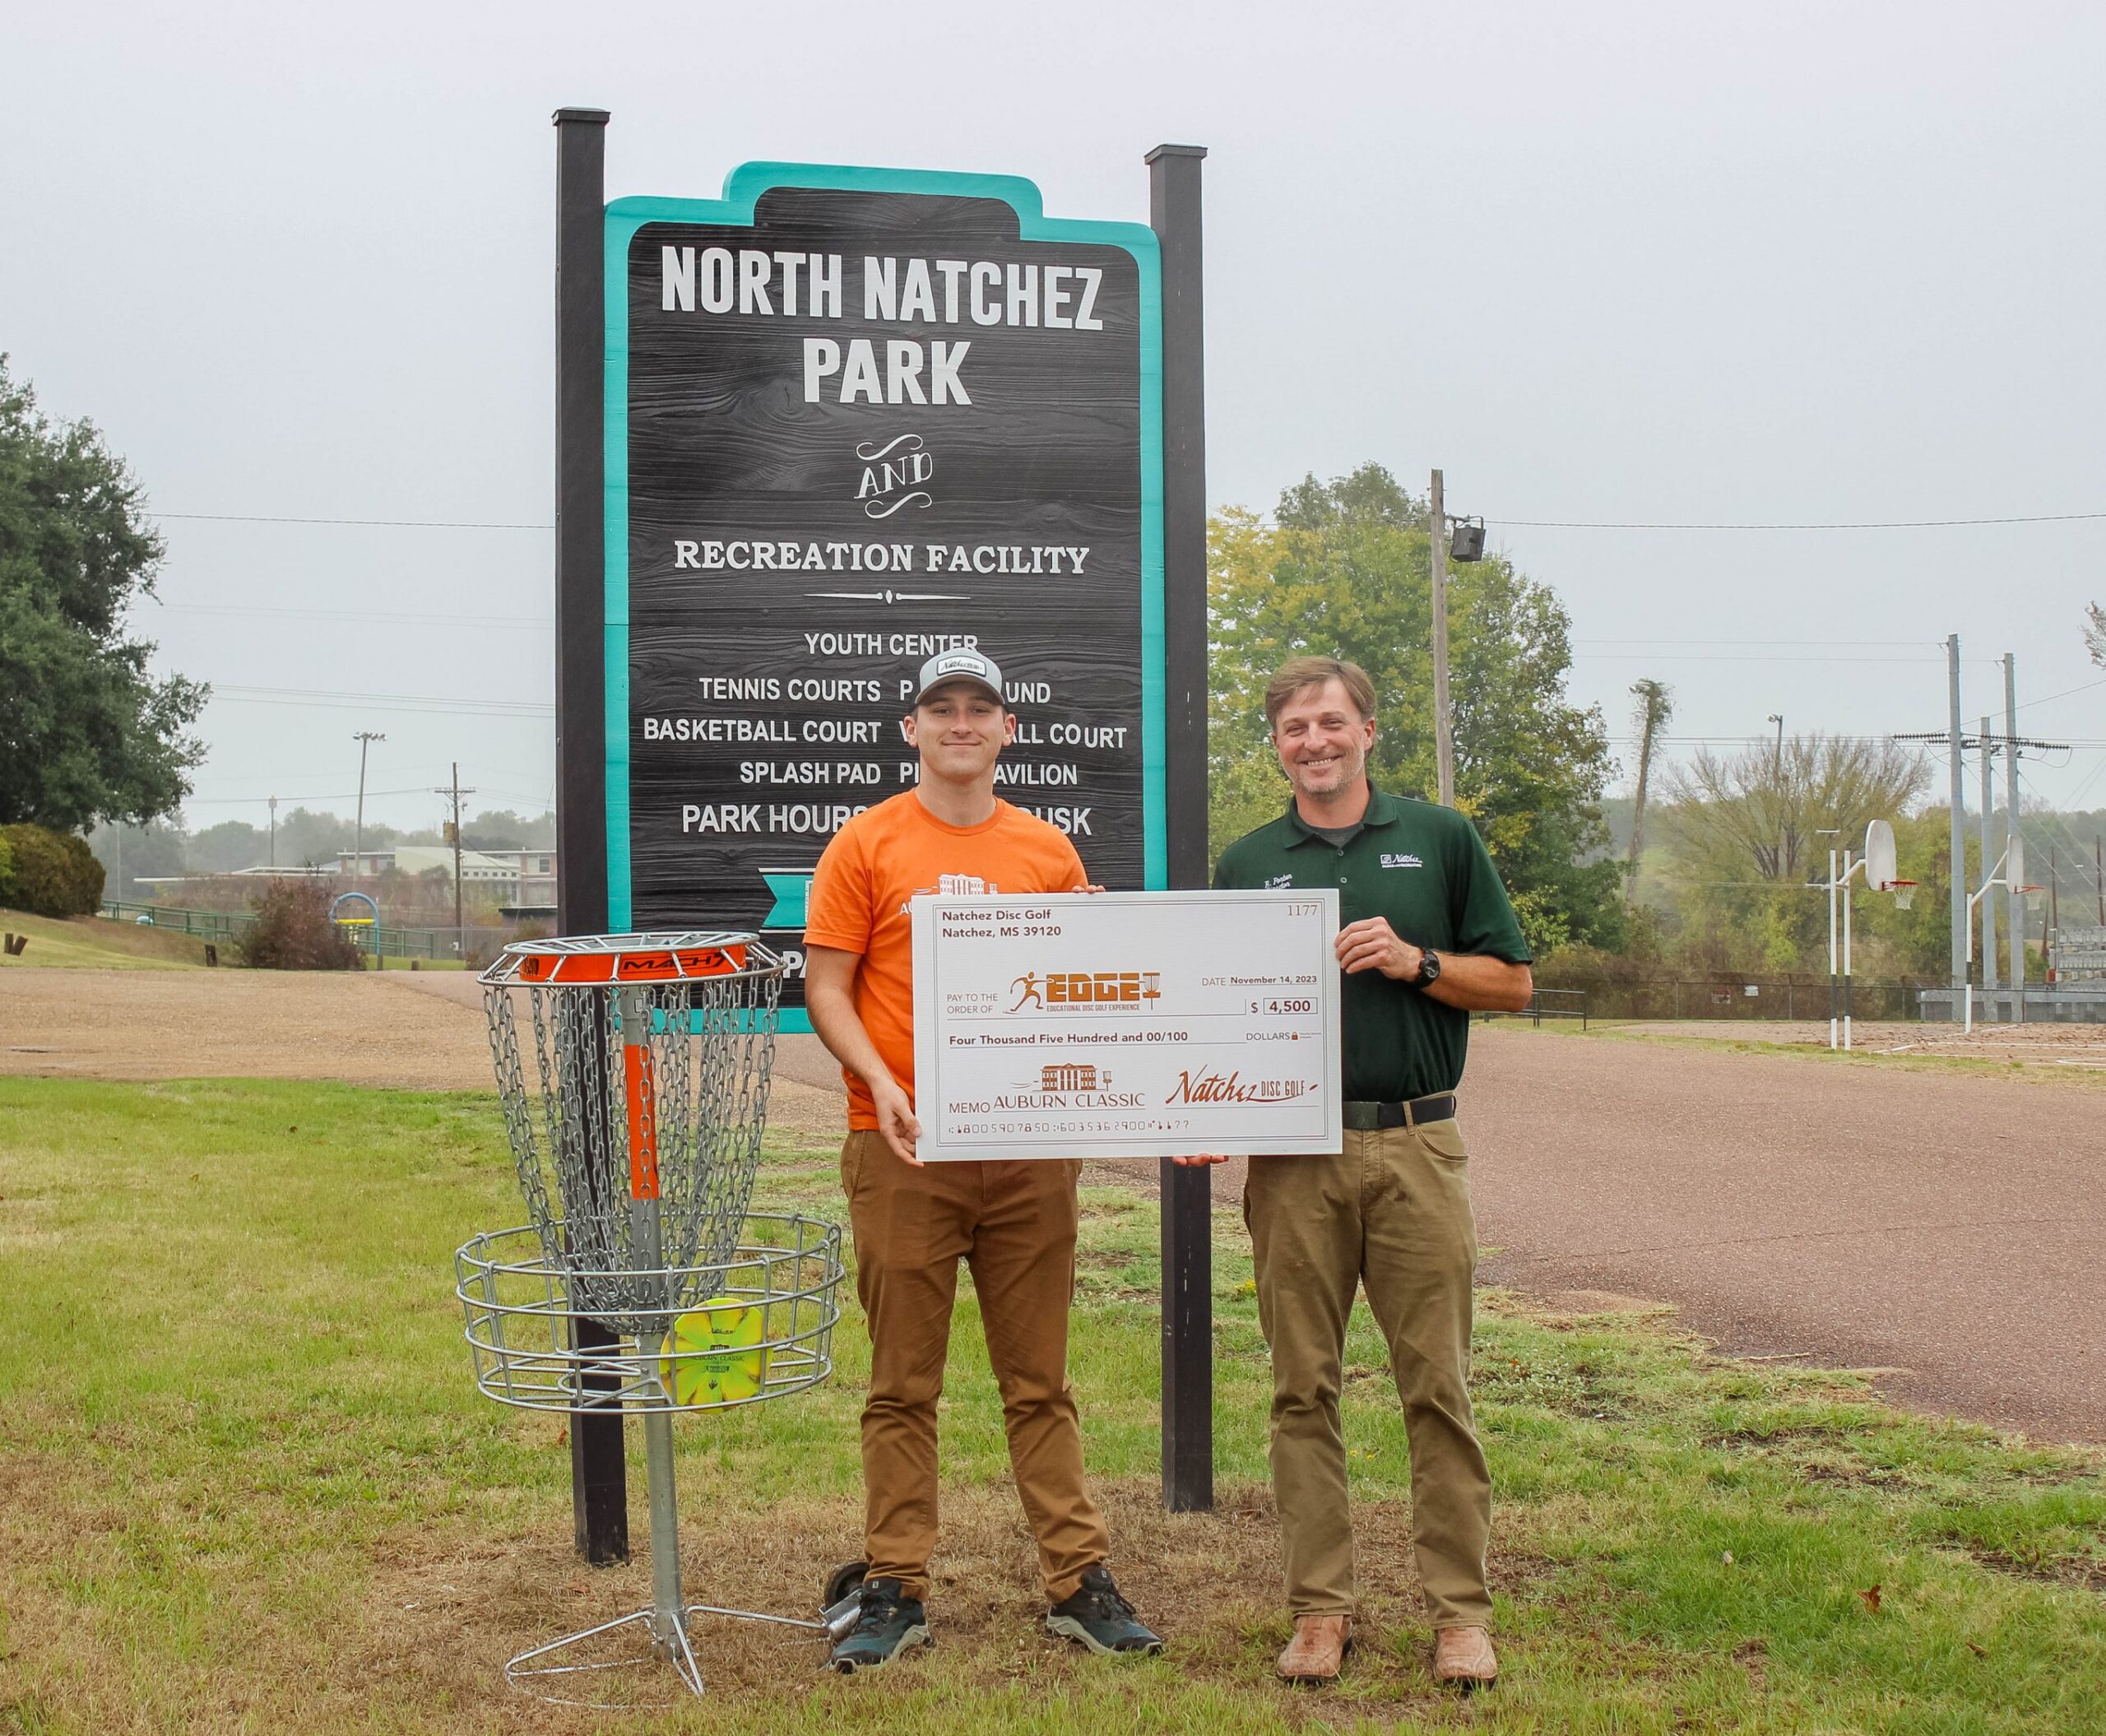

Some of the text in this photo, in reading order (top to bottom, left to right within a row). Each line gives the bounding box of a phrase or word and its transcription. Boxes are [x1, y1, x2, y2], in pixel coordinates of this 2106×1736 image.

[661, 244, 1103, 331] NORTH NATCHEZ
[803, 338, 972, 406] PARK
[854, 451, 934, 499] AND
[674, 541, 1090, 574] RECREATION FACILITY
[804, 634, 883, 656] YOUTH
[699, 677, 781, 701] TENNIS
[787, 679, 881, 703] COURTS
[643, 718, 797, 742] BASKETBALL
[802, 721, 882, 744] COURT
[1050, 723, 1127, 750] COURT
[740, 762, 830, 785] SPLASH
[837, 762, 881, 784] PAD
[993, 764, 1079, 786] AVILION
[682, 805, 762, 833] PARK
[942, 908, 1051, 921] Natchez Disc Golf
[1287, 904, 1318, 917] 1177
[942, 926, 1061, 940] Natchez, MS 39120
[1046, 973, 1140, 1002] EDGE
[1201, 975, 1317, 986] DATE November 14, 2023
[947, 1005, 993, 1014] ORDER OF
[1250, 1000, 1311, 1015] $ 4,500
[949, 1031, 1188, 1045] Four Thousand Five Hundred and 00/100
[1246, 1033, 1290, 1041] DOLLARS
[1165, 1064, 1305, 1104] Natchez DISC GOLF
[949, 1092, 1146, 1114] MEMO AUBURN CLASSIC
